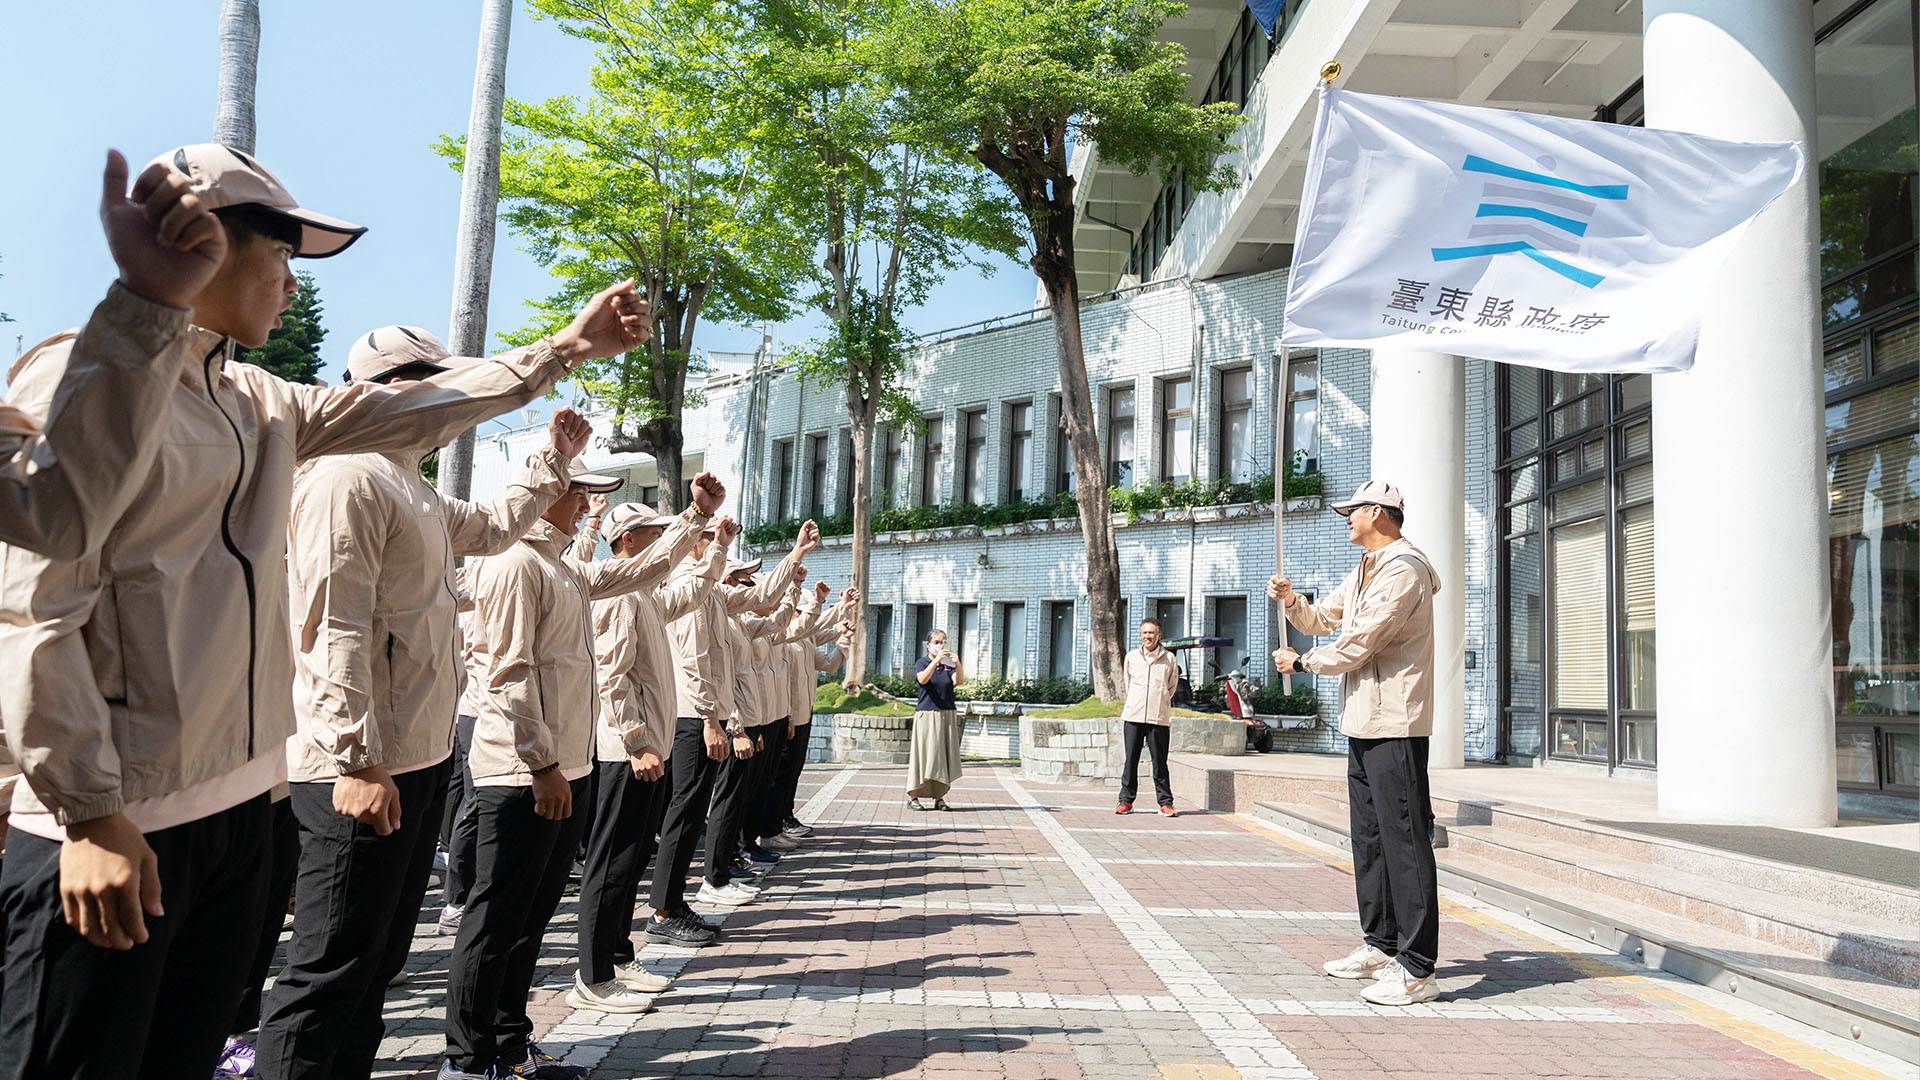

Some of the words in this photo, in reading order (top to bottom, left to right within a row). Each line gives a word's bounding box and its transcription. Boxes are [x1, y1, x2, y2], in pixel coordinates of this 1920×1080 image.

[1387, 278, 1610, 329] 臺東縣政府
[1382, 314, 1436, 334] Taitung
